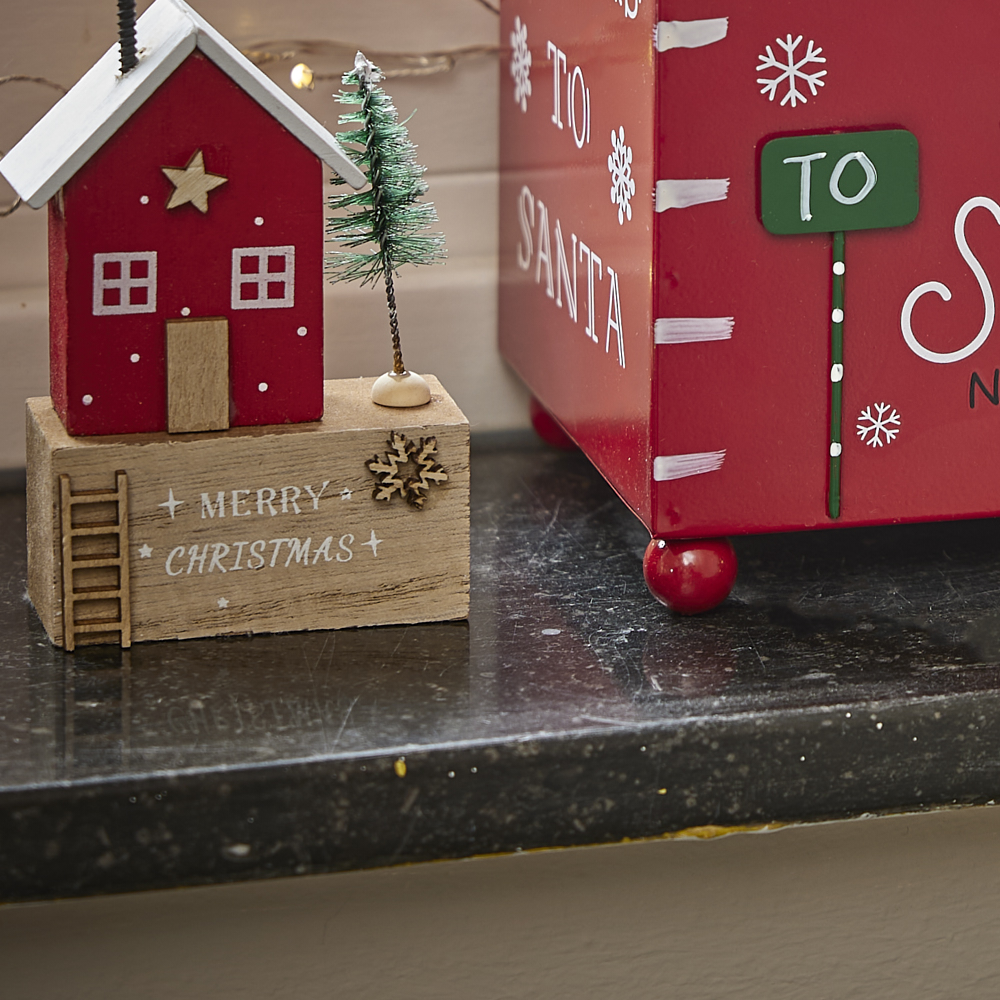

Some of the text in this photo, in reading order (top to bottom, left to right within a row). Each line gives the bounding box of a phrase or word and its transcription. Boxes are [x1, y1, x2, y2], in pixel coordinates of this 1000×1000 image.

[546, 40, 592, 149] TO
[783, 150, 879, 222] TO
[516, 184, 627, 370] SANTA
[199, 480, 331, 520] MERRY
[164, 532, 357, 577] CHRISTMAS
